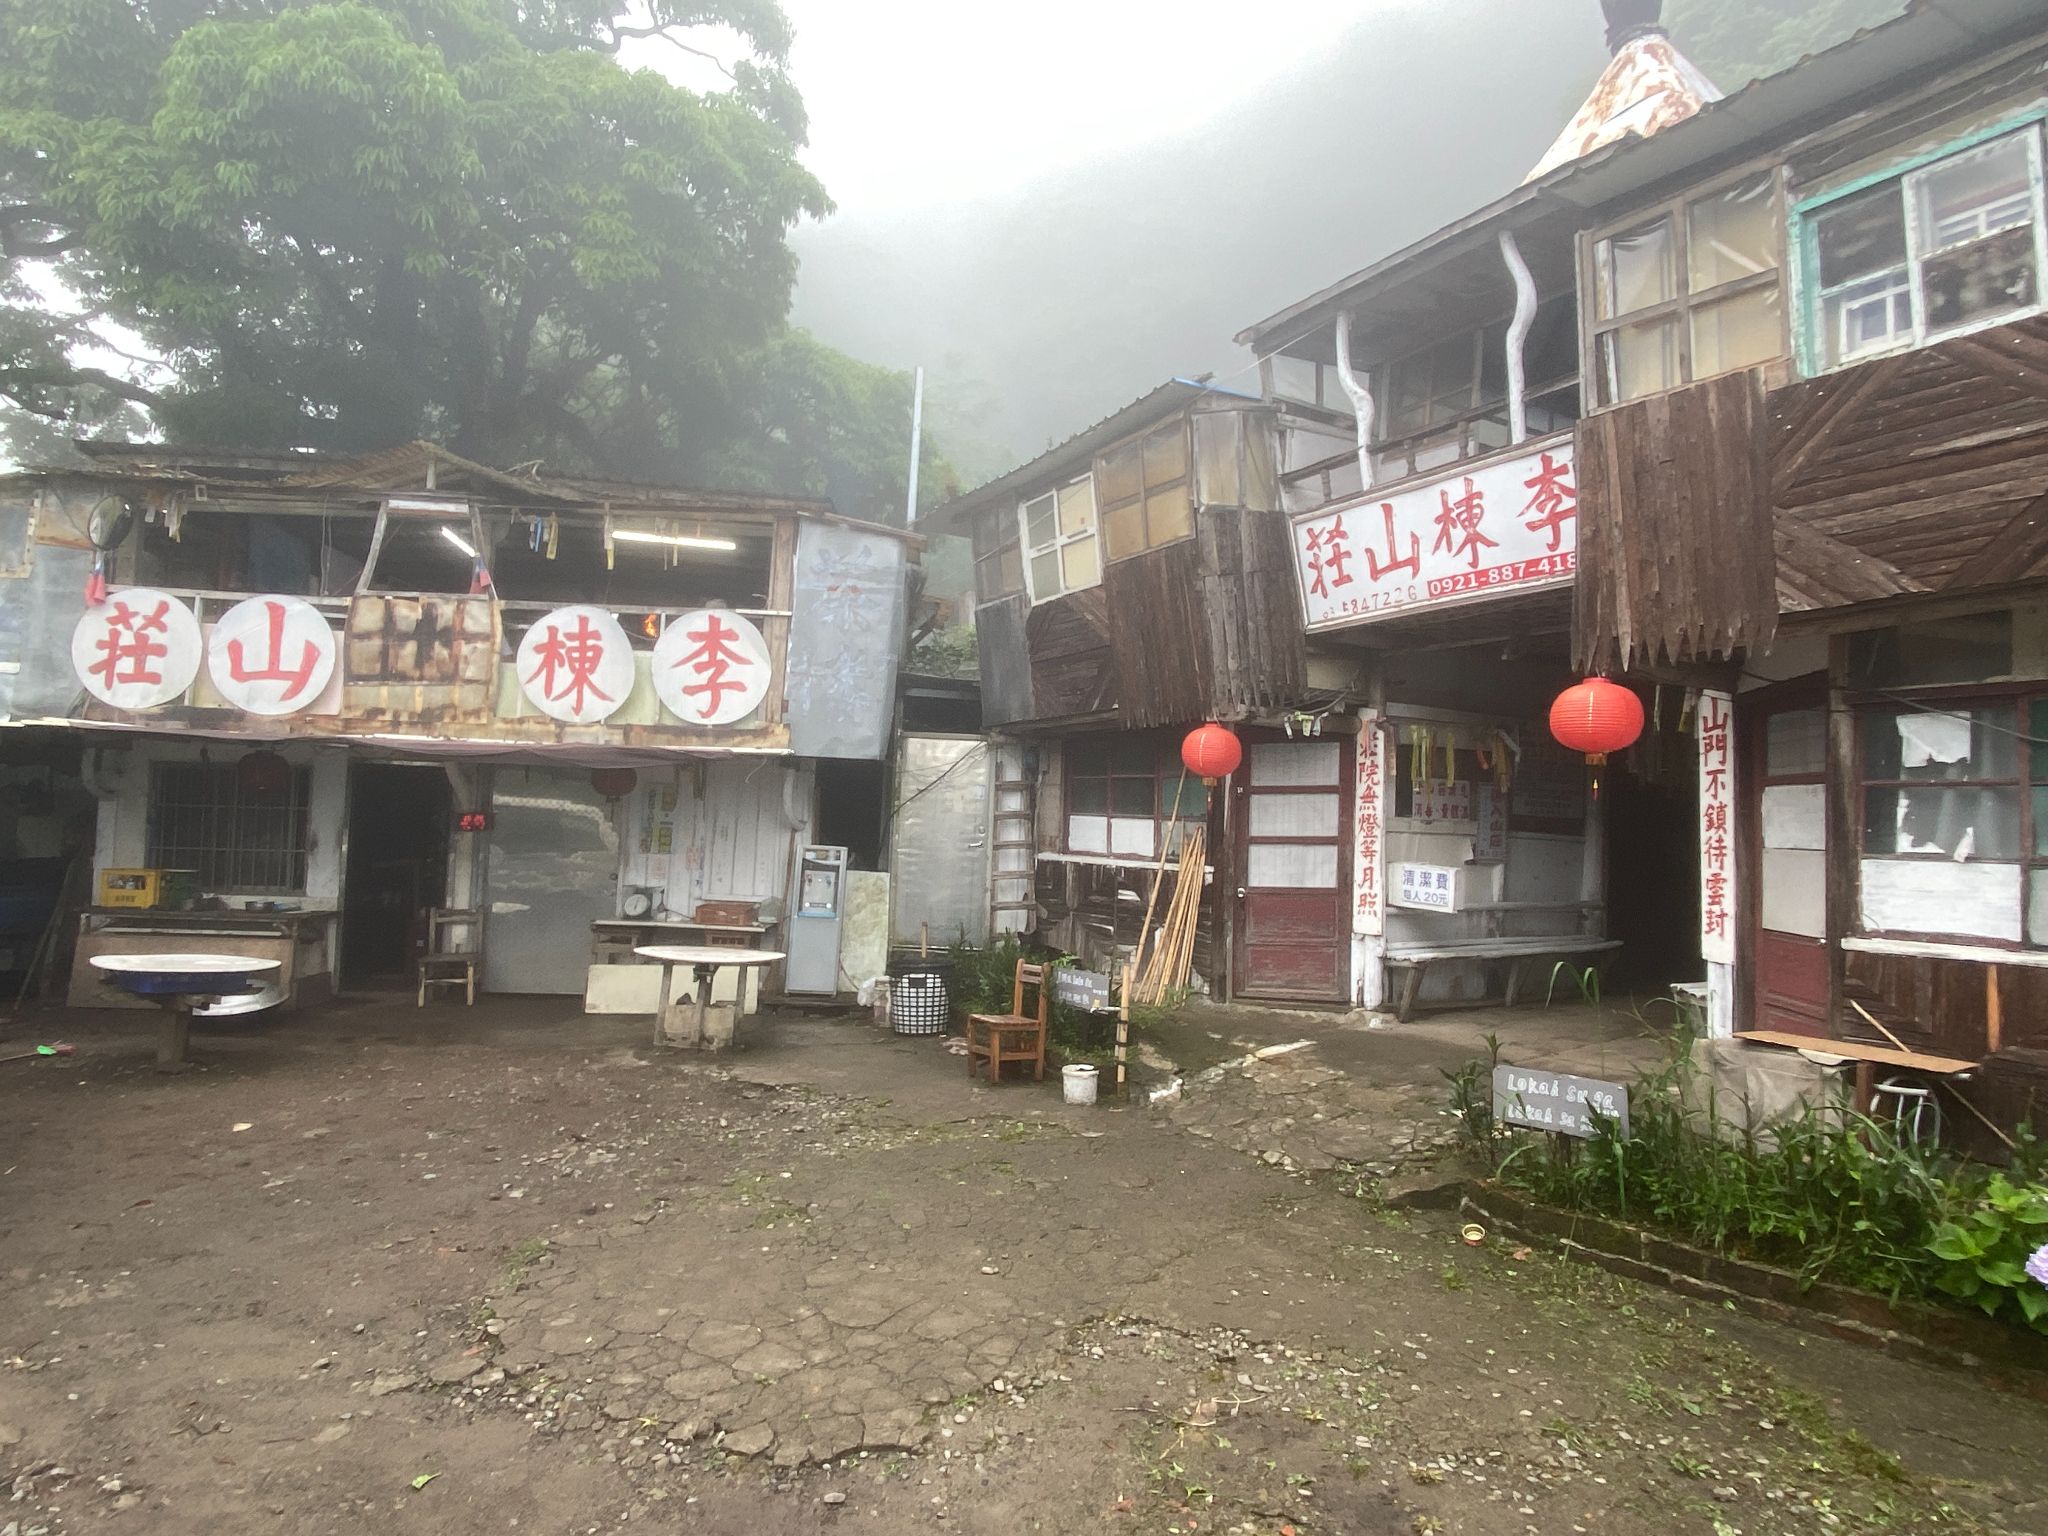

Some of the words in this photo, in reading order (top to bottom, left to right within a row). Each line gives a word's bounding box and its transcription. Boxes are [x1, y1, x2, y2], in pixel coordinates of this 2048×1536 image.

[1430, 552, 1576, 595] 0921-887-418
[1700, 696, 1729, 939] 山門不鎖待雲封
[1402, 869, 1448, 891] 清潔費
